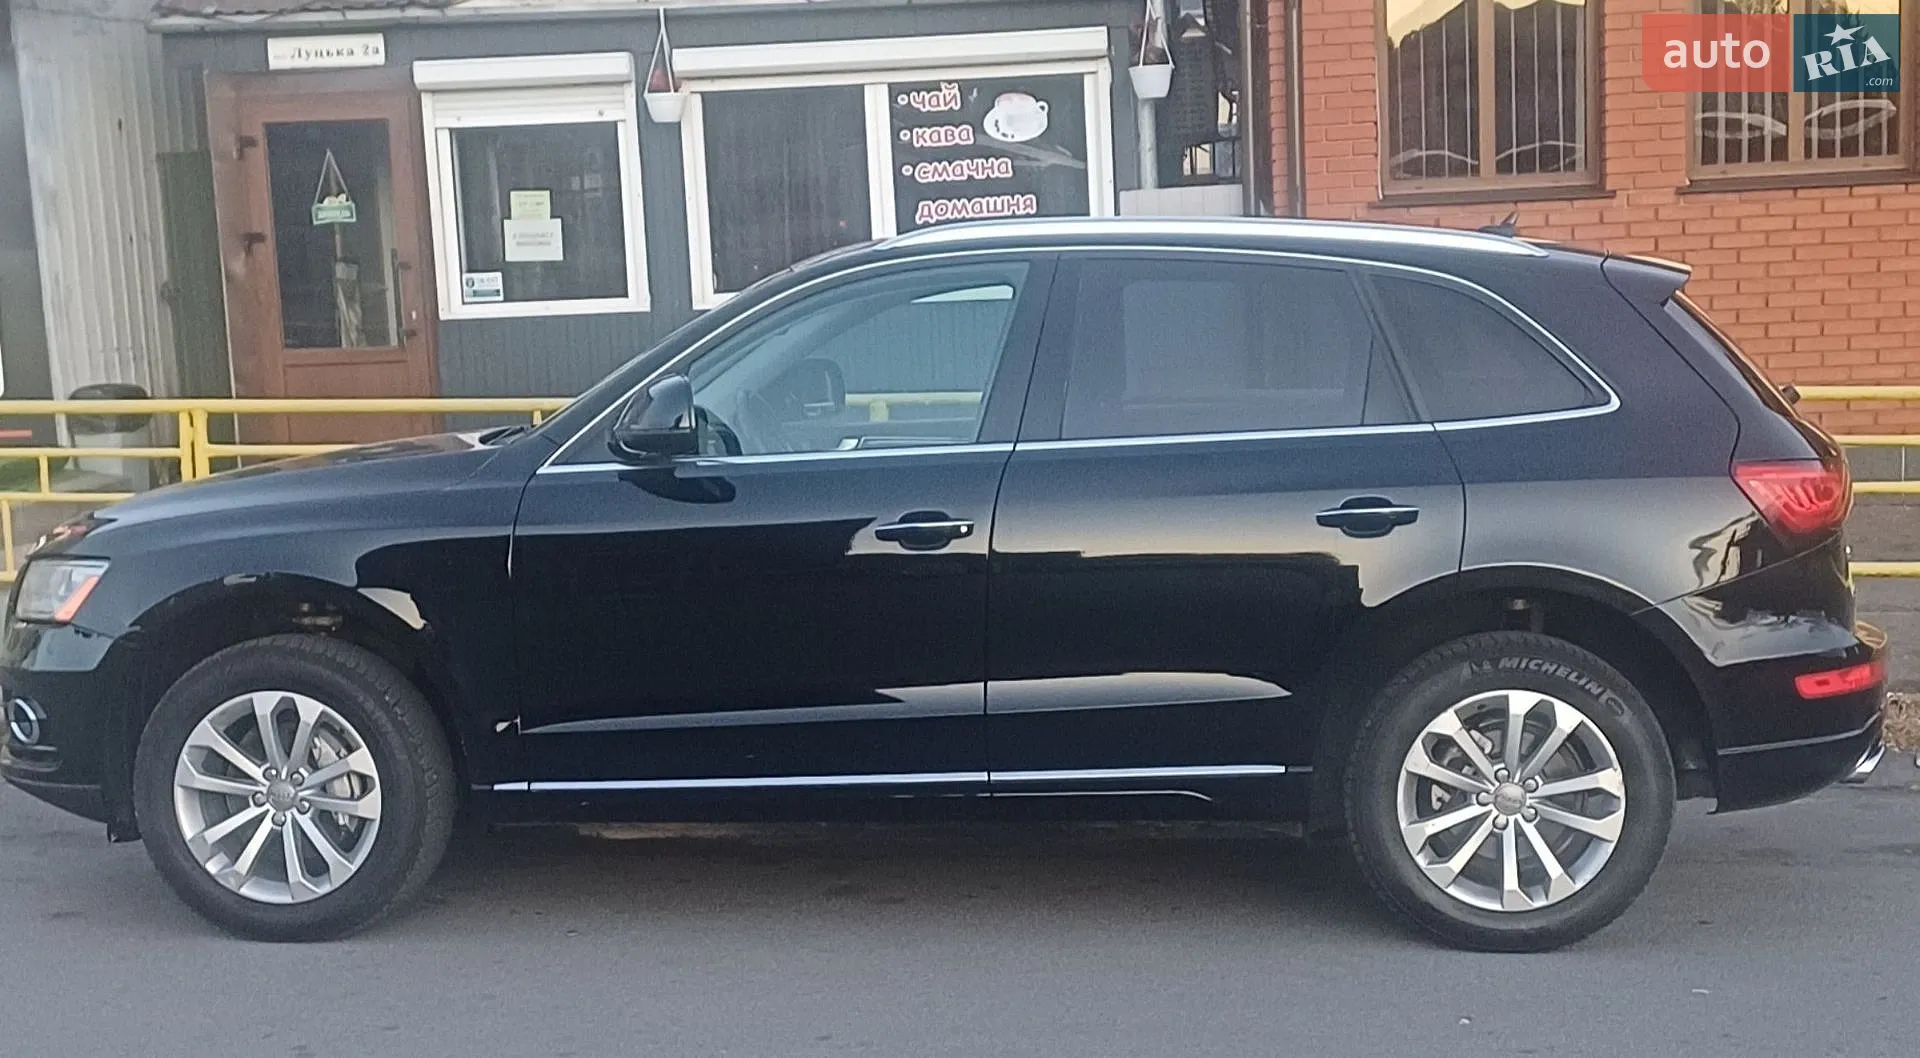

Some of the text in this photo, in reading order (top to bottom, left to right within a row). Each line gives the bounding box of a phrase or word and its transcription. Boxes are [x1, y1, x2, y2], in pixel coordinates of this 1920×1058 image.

[290, 47, 355, 61] Луцька
[911, 82, 960, 111] чай
[913, 125, 974, 147] кава
[915, 158, 1013, 182] смачна
[916, 194, 1037, 223] домашня
[1498, 656, 1605, 696] MICHELIN
